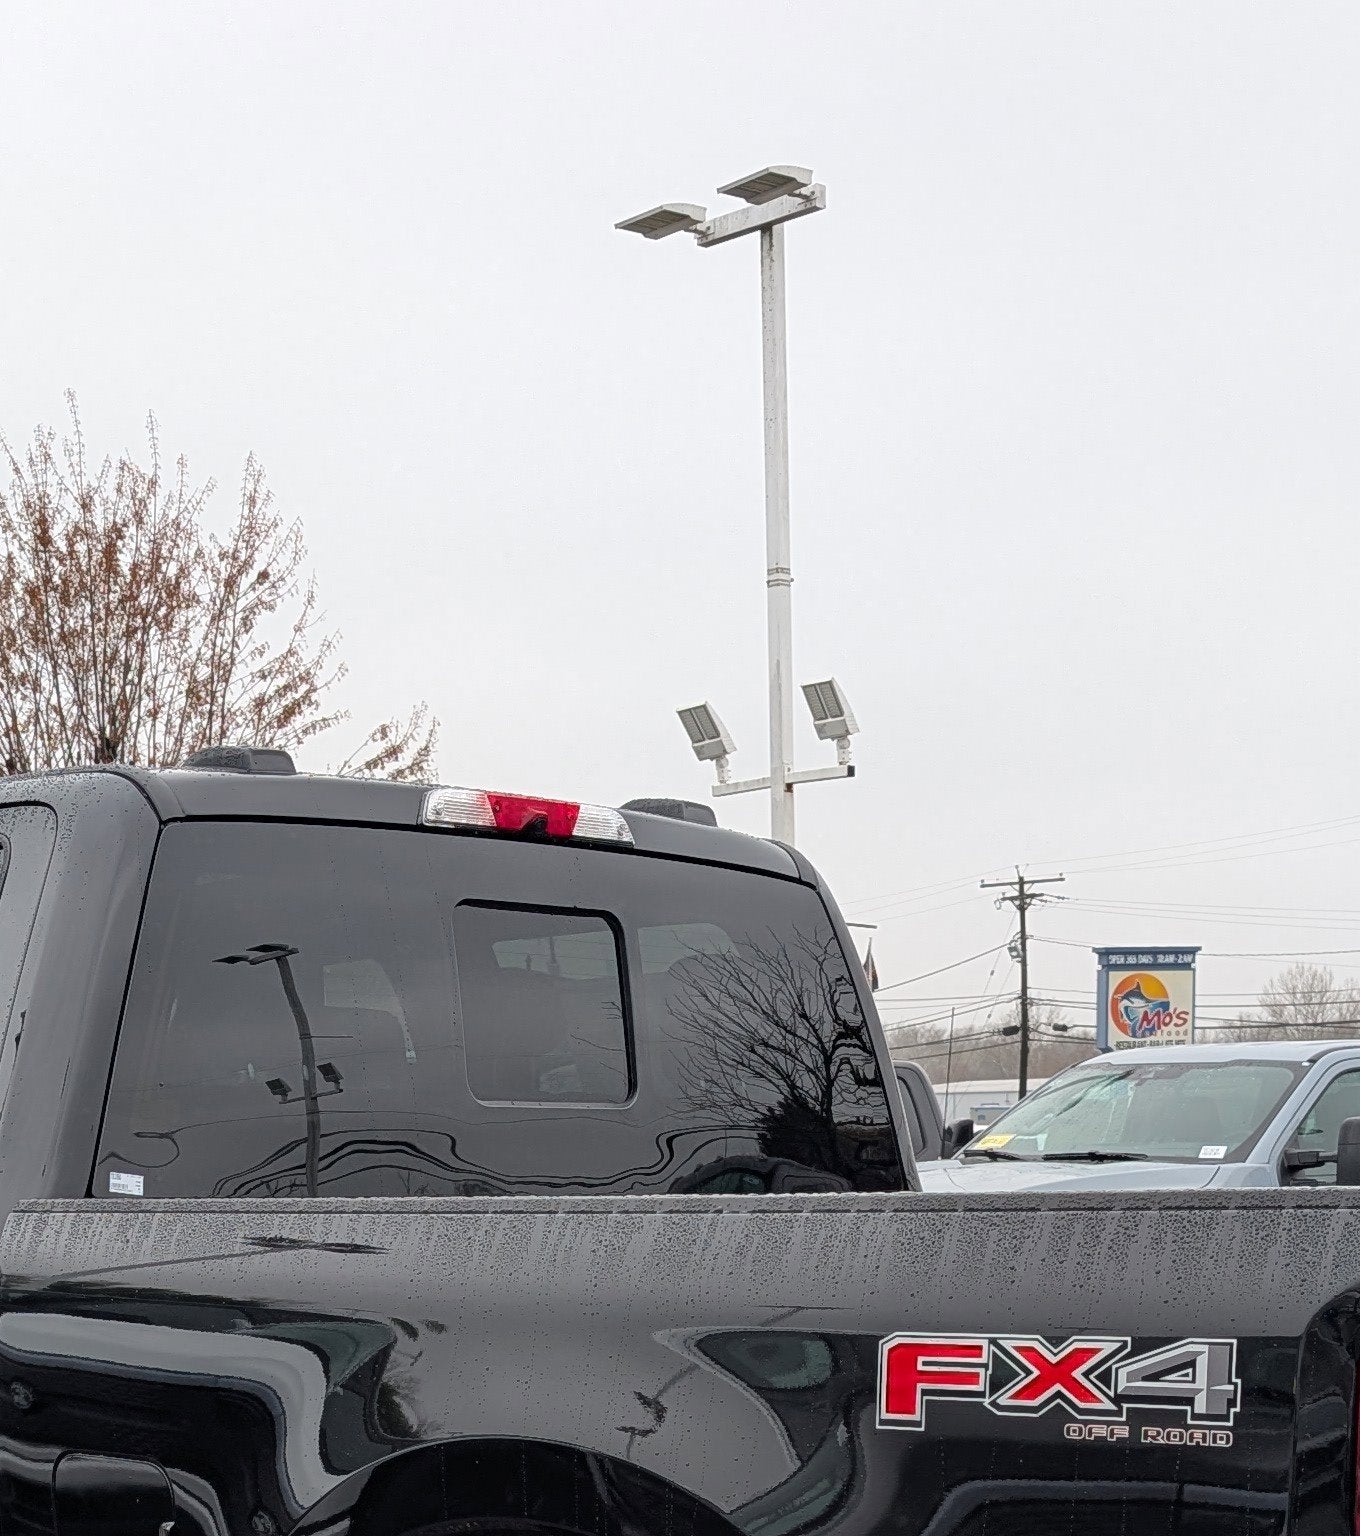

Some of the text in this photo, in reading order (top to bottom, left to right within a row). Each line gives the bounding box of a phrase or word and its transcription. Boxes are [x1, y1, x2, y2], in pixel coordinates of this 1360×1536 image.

[876, 1332, 1242, 1431] FX4
[1064, 1424, 1234, 1448] OFF ROAD
